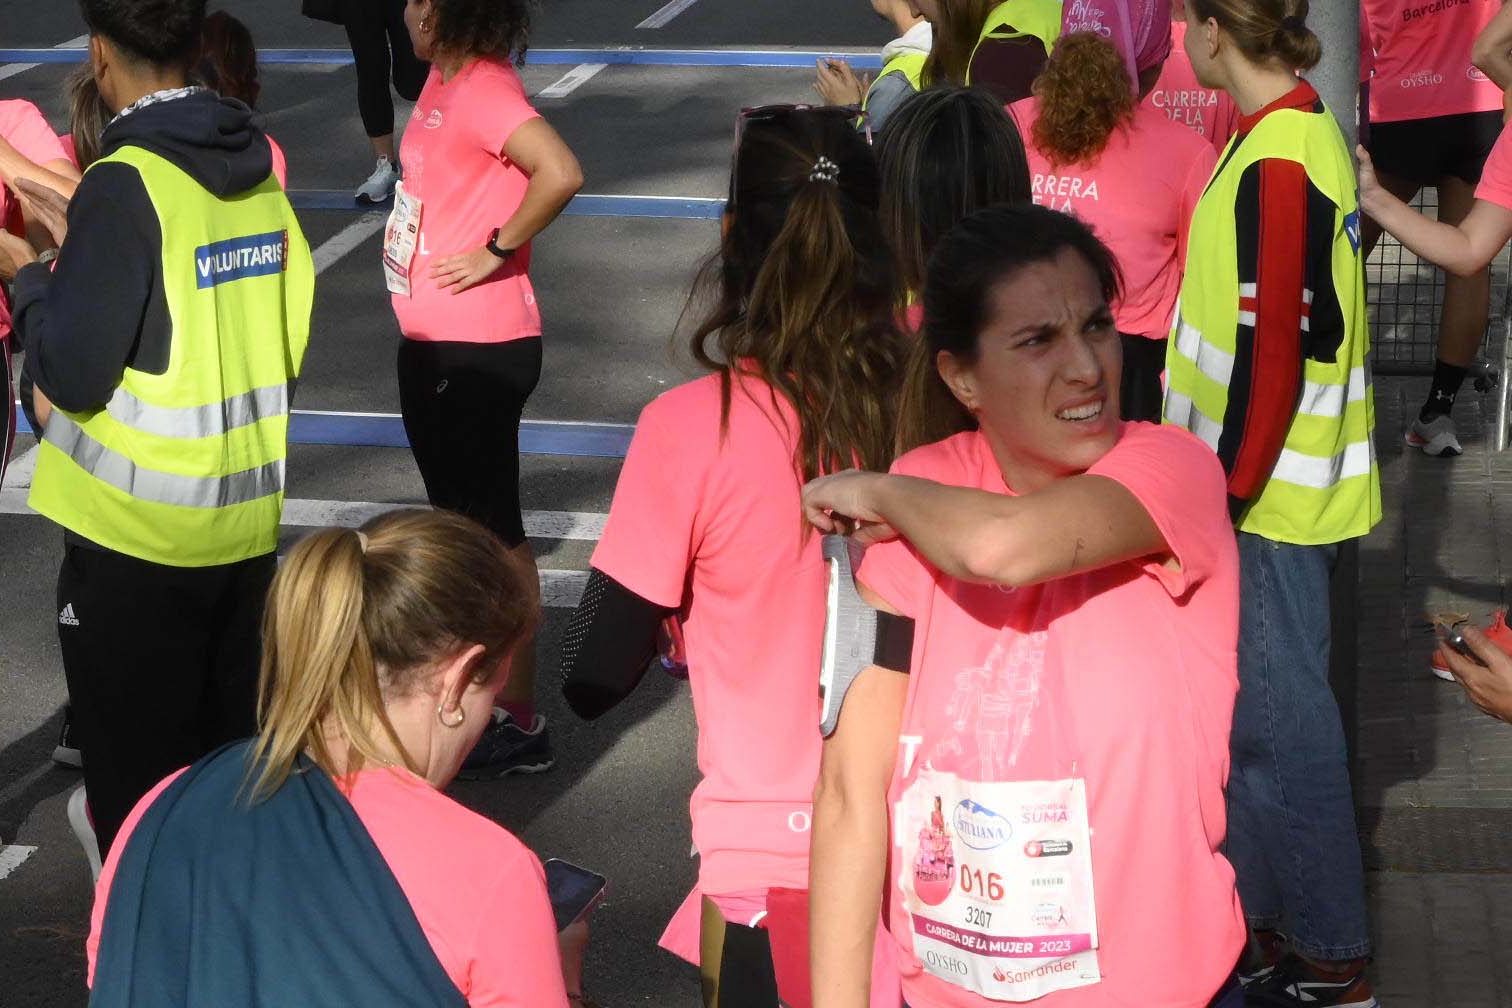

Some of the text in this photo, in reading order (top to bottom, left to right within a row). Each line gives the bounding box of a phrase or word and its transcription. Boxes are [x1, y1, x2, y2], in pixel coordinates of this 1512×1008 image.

[1399, 74, 1443, 89] OYSHO
[1152, 89, 1218, 108] CARRERA
[1185, 109, 1203, 123] LA
[197, 244, 285, 279] VOLUNTARIS
[1021, 810, 1069, 825] SUMA
[960, 863, 1005, 901] 016
[965, 906, 992, 929] 3207
[925, 922, 1072, 954] CARRERA DE LA MUJER 2023
[926, 950, 1078, 984] OYSHO Santander
